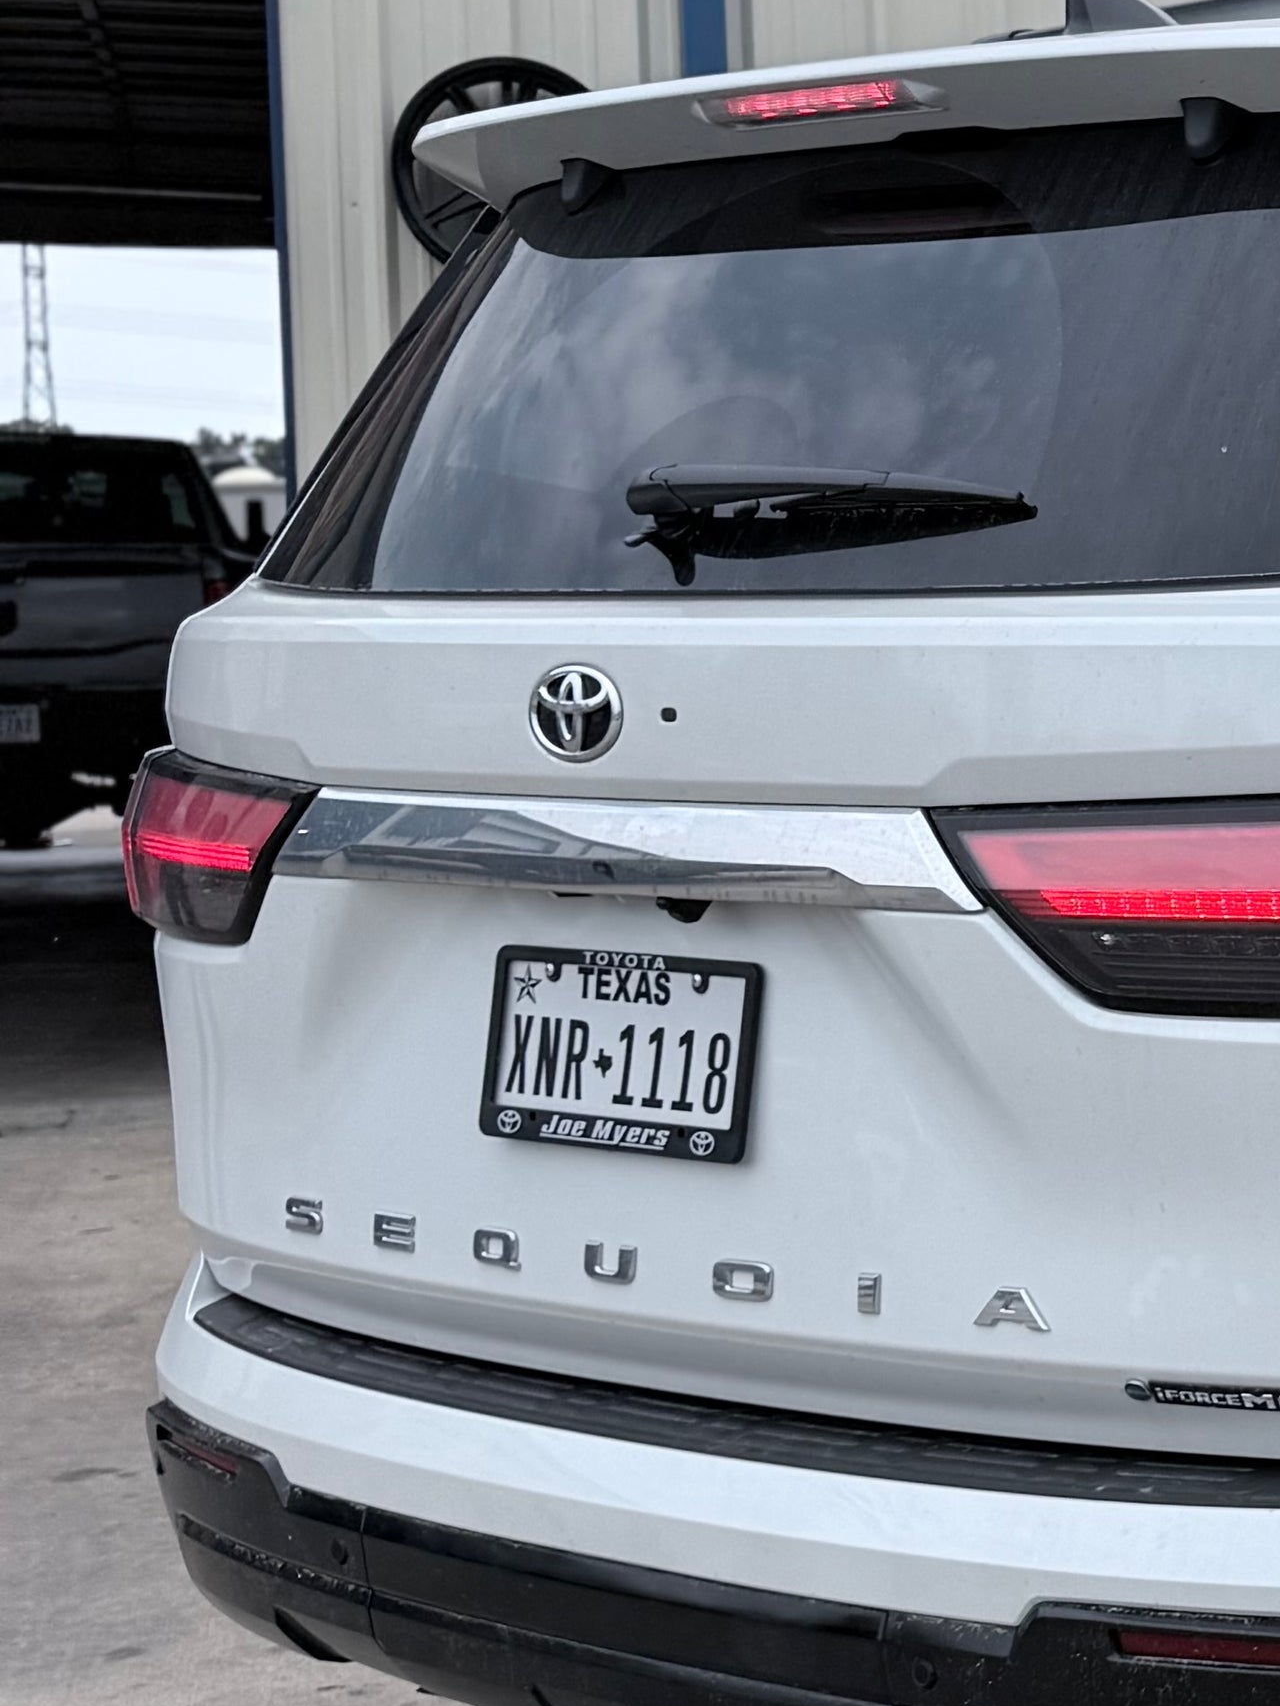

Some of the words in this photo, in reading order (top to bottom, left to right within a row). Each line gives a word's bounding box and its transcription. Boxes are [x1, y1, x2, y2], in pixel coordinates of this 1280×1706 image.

[583, 951, 667, 971] TOYOTA
[578, 966, 671, 1006] TEXAS
[540, 1113, 587, 1138] Joe
[590, 1119, 671, 1148] Myers
[285, 1196, 1052, 1332] SEQUOIA
